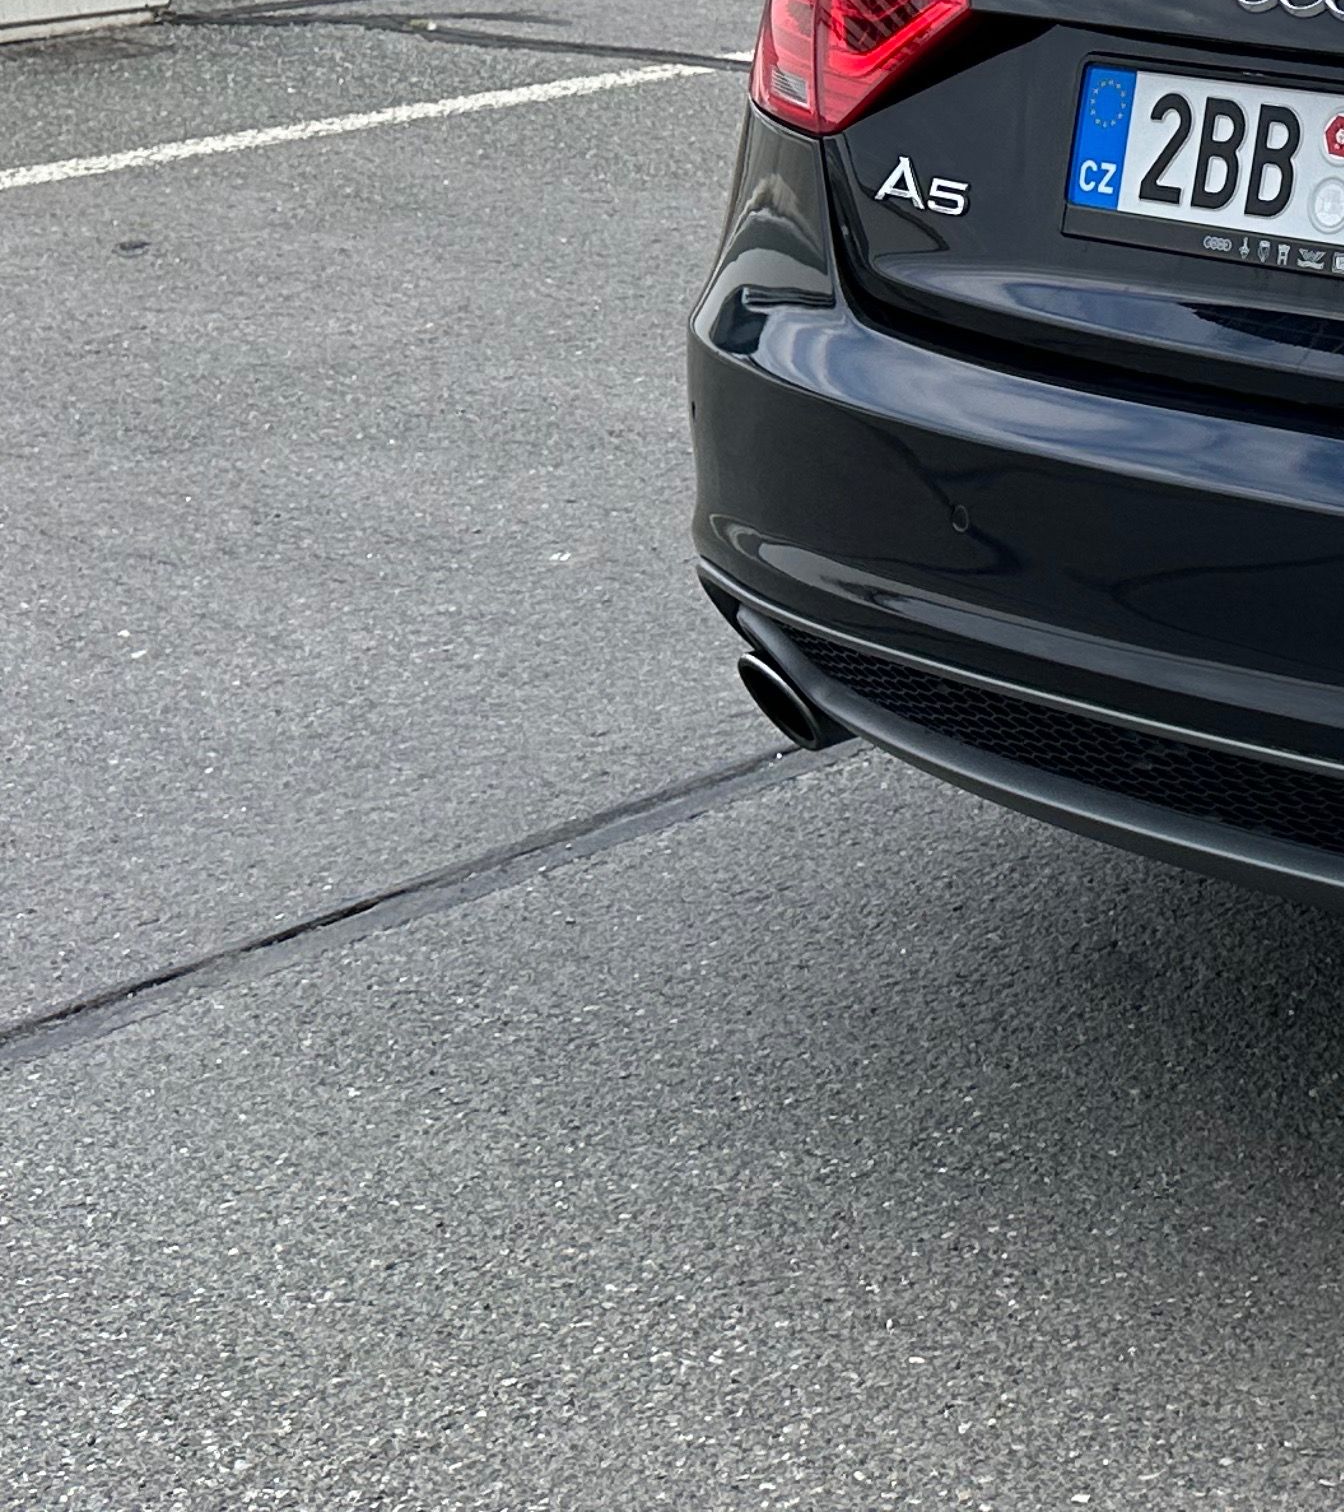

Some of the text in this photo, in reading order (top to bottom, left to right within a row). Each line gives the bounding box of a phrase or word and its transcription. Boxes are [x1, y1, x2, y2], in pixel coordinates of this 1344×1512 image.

[1079, 159, 1117, 195] CZ
[1139, 93, 1301, 218] 2BB
[874, 156, 969, 216] A5
